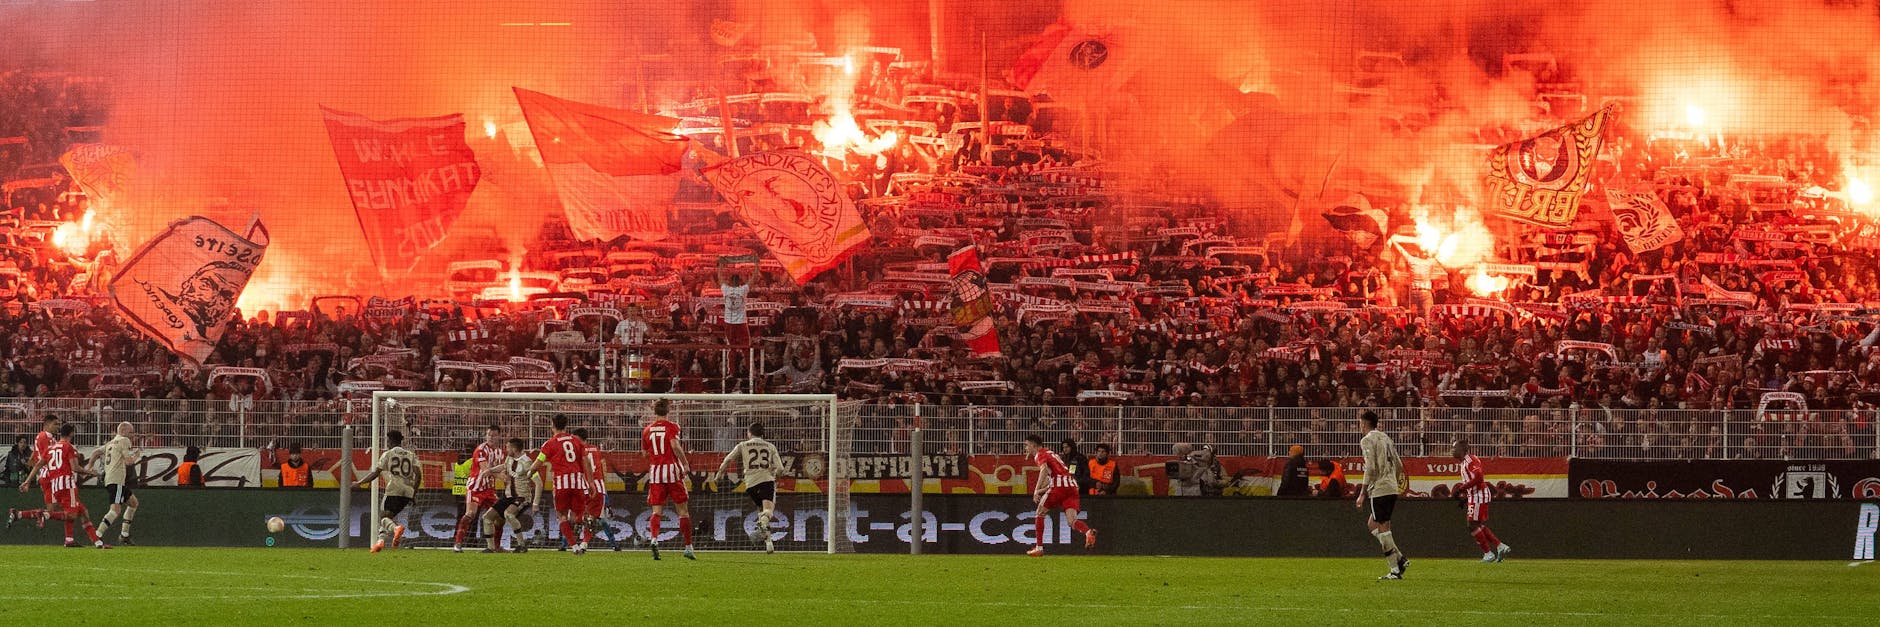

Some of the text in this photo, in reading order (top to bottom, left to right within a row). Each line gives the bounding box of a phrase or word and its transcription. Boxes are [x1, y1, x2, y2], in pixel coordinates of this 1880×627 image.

[350, 162, 477, 210] SYNDIKAT
[561, 441, 577, 463] 8
[649, 432, 666, 455] 17
[47, 448, 63, 471] 20
[390, 456, 412, 477] 20
[748, 449, 770, 469] 23
[713, 503, 1088, 545] rent-a-car
